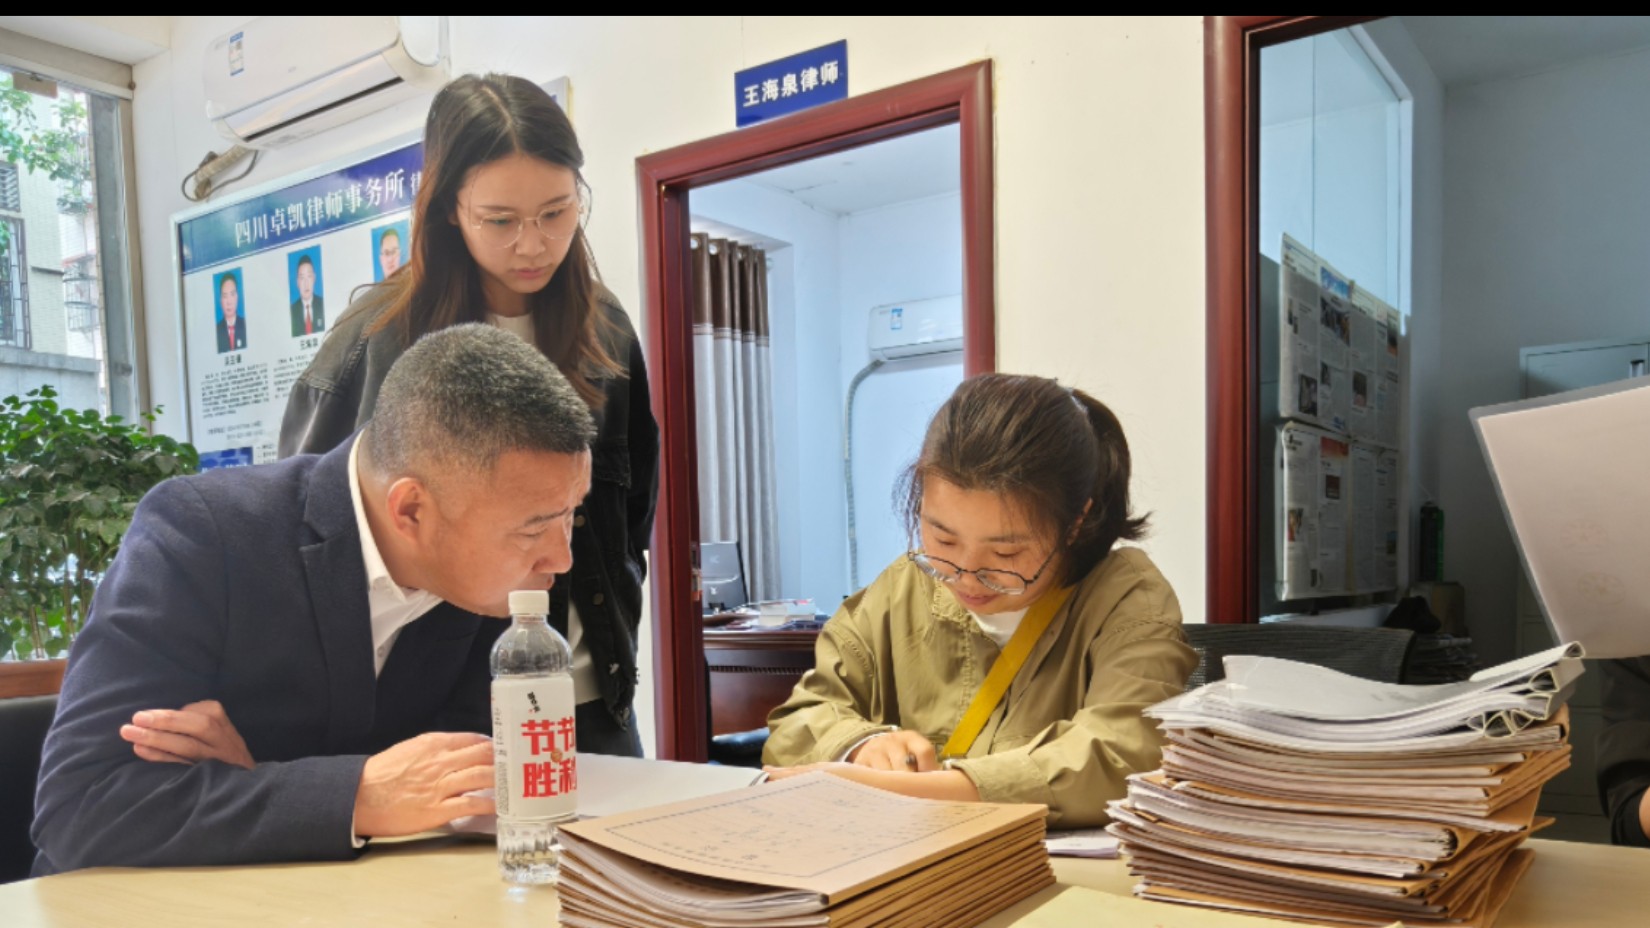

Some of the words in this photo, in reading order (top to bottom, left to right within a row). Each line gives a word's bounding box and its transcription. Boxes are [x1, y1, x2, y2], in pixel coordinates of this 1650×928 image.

[742, 60, 839, 107] 王海泉律师
[235, 168, 404, 248] 四川卓凯律师事务所
